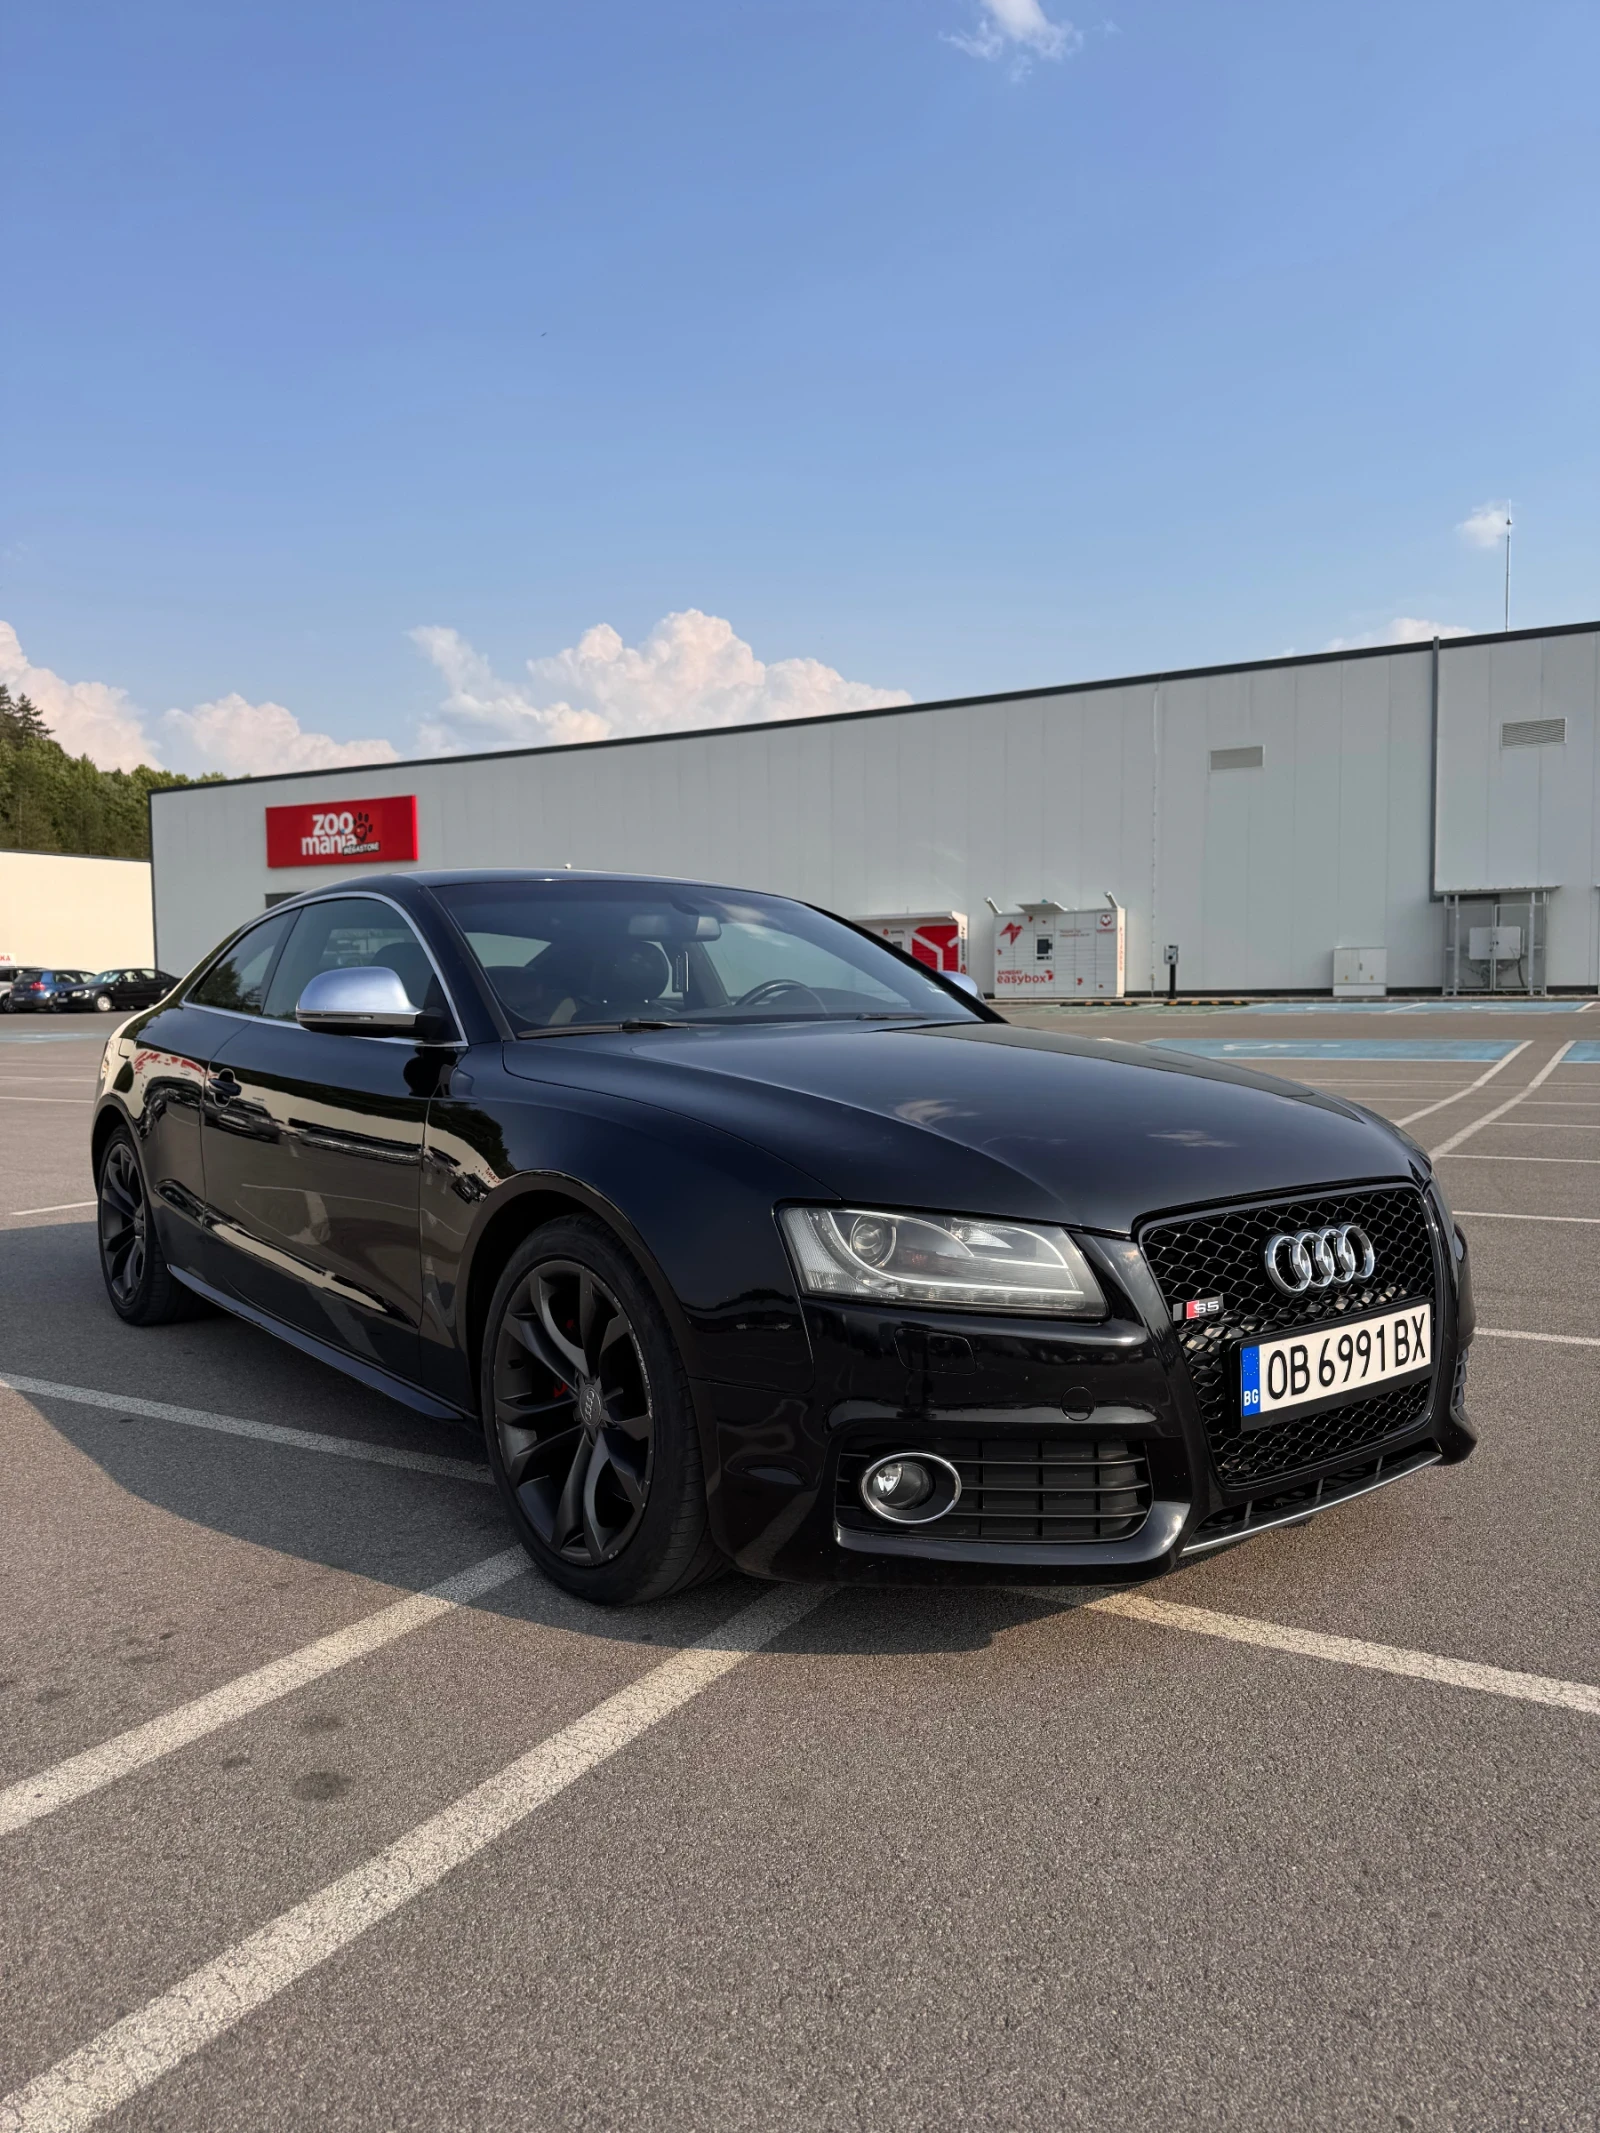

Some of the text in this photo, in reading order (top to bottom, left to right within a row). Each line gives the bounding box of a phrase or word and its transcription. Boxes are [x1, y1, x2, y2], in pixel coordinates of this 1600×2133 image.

[301, 834, 357, 856] mania
[996, 973, 1046, 986] easybox
[1193, 1301, 1220, 1314] S5
[1319, 1324, 1386, 1387] 6991
[1243, 1388, 1259, 1406] BG
